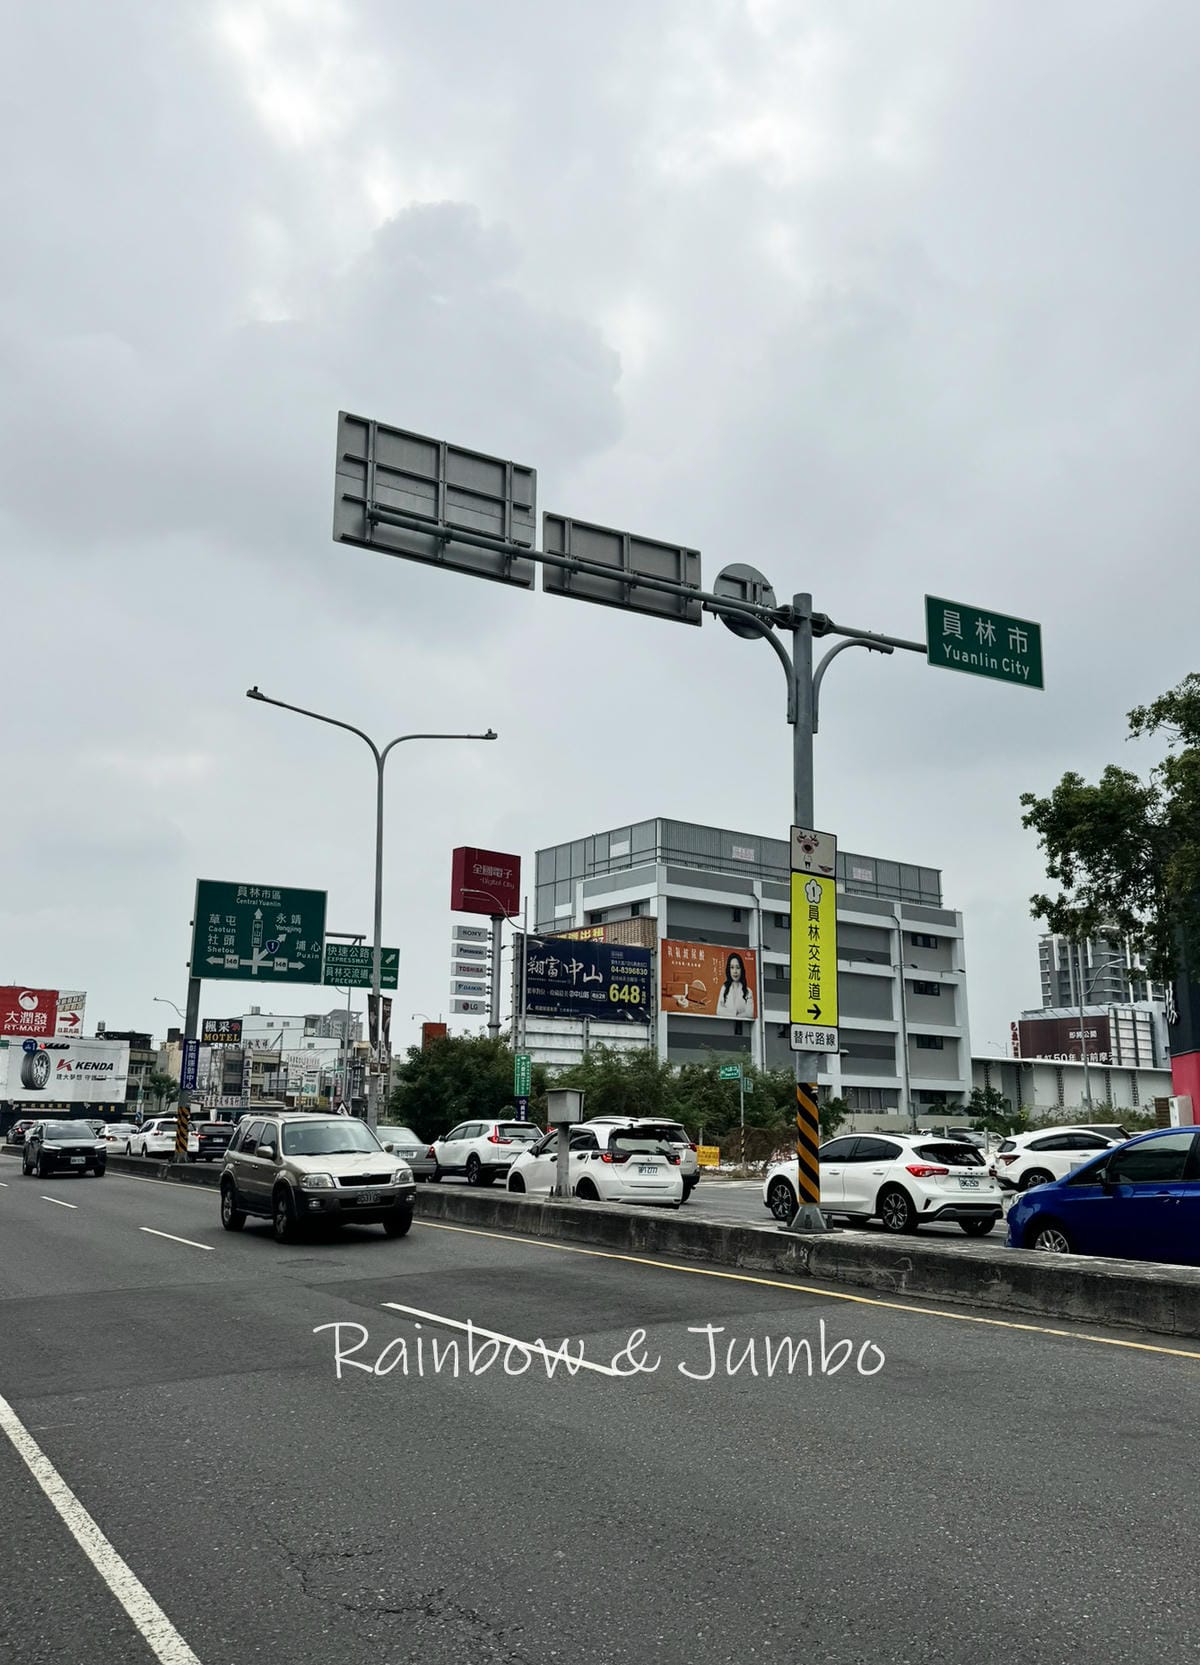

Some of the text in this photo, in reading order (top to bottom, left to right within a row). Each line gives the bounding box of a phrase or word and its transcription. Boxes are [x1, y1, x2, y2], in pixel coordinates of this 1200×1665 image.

[942, 609, 1028, 654] 員林市
[943, 643, 1030, 680] Yuanlin City
[472, 863, 513, 880] 全國電子
[237, 885, 281, 900] 員林市區
[208, 913, 237, 926] 草屯
[208, 925, 236, 933] Caotun
[207, 934, 235, 946] 社頭
[207, 945, 235, 954] Shetou
[296, 951, 320, 959] Puxin
[327, 945, 370, 958] 快速公路
[807, 904, 821, 1001] 員林交流道
[327, 956, 369, 964] EXPRESSWAY
[609, 983, 641, 1004] 648
[4, 1010, 48, 1026] 大潤發
[3, 1024, 47, 1033] RT-MART
[203, 1033, 240, 1042] MOTEL
[793, 1030, 836, 1046] 替代路線
[75, 1062, 114, 1071] KENDA
